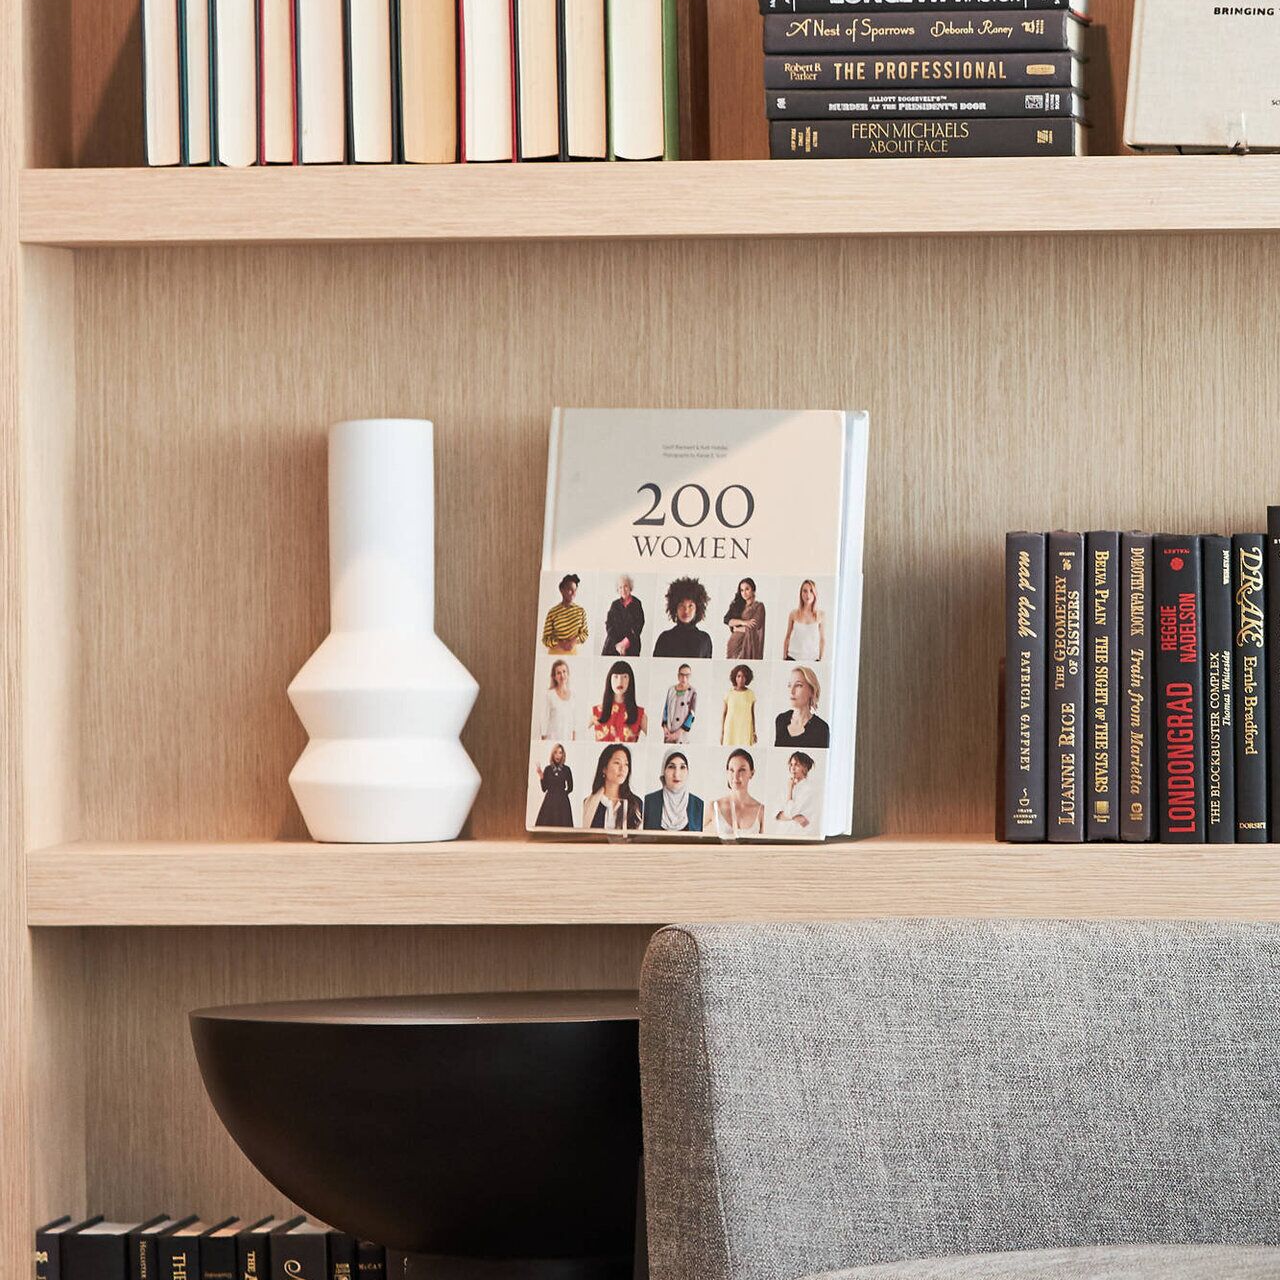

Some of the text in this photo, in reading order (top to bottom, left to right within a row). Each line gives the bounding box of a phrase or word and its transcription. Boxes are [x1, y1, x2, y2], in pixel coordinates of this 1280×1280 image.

[786, 18, 915, 42] A Nest of Sparrows
[930, 19, 1013, 38] Deborah Raney
[1214, 7, 1274, 16] BRINGING
[834, 61, 1007, 80] THE PROFESSIONAL
[852, 123, 969, 138] FERN MICHAELS
[869, 140, 948, 153] ABOUT FACE
[633, 483, 755, 528] 200
[633, 535, 752, 559] WOMEN
[1018, 551, 1036, 638] mad dash
[1236, 547, 1263, 648] DRAKE
[1160, 606, 1177, 650] REGGIE
[1179, 594, 1196, 662] NADELSON
[1020, 651, 1029, 771] PATRICIA GAFFNEY
[1129, 649, 1144, 794] Train from Marietta
[1244, 656, 1258, 754] Ernle Bradford
[1166, 683, 1195, 832] LONDONGRAD
